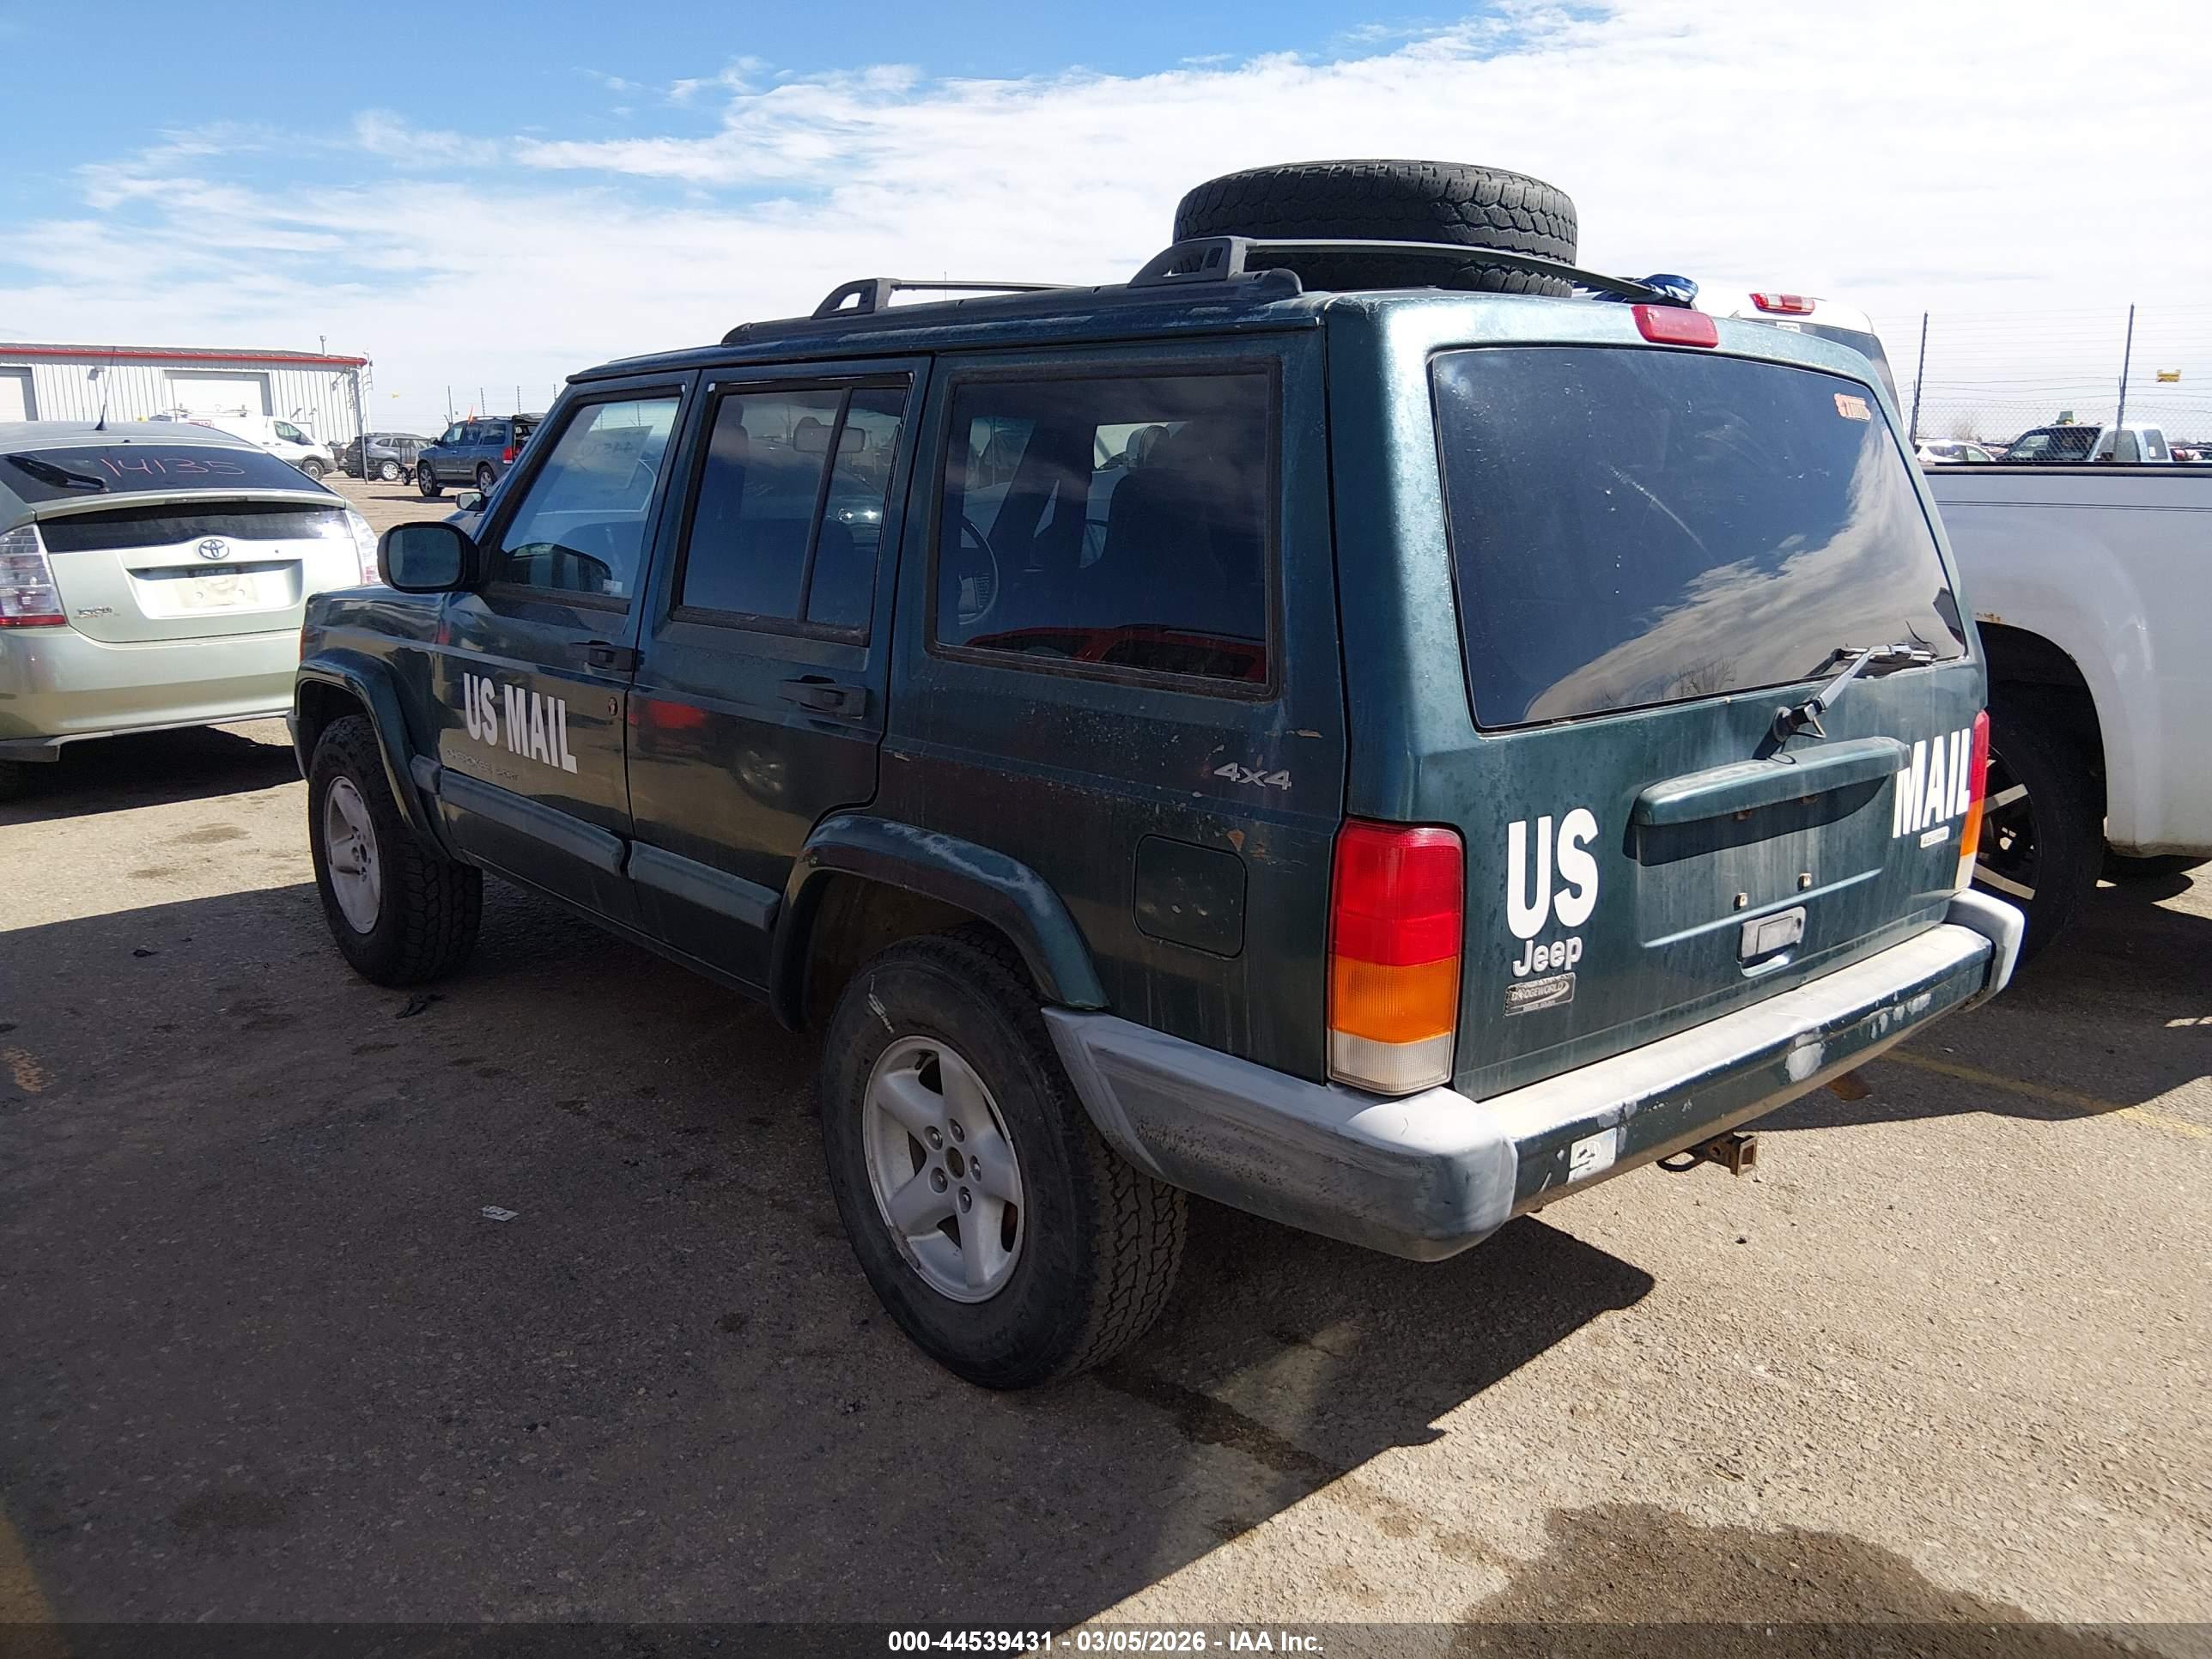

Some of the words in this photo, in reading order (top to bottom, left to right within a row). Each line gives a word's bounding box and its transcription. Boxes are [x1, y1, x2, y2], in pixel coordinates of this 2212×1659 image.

[100, 459, 245, 477] 14135
[464, 672, 498, 746] US
[504, 684, 578, 775] MAIL
[1507, 808, 1599, 939] US
[1892, 727, 1971, 839] MAIL
[1512, 937, 1583, 978] Jeep
